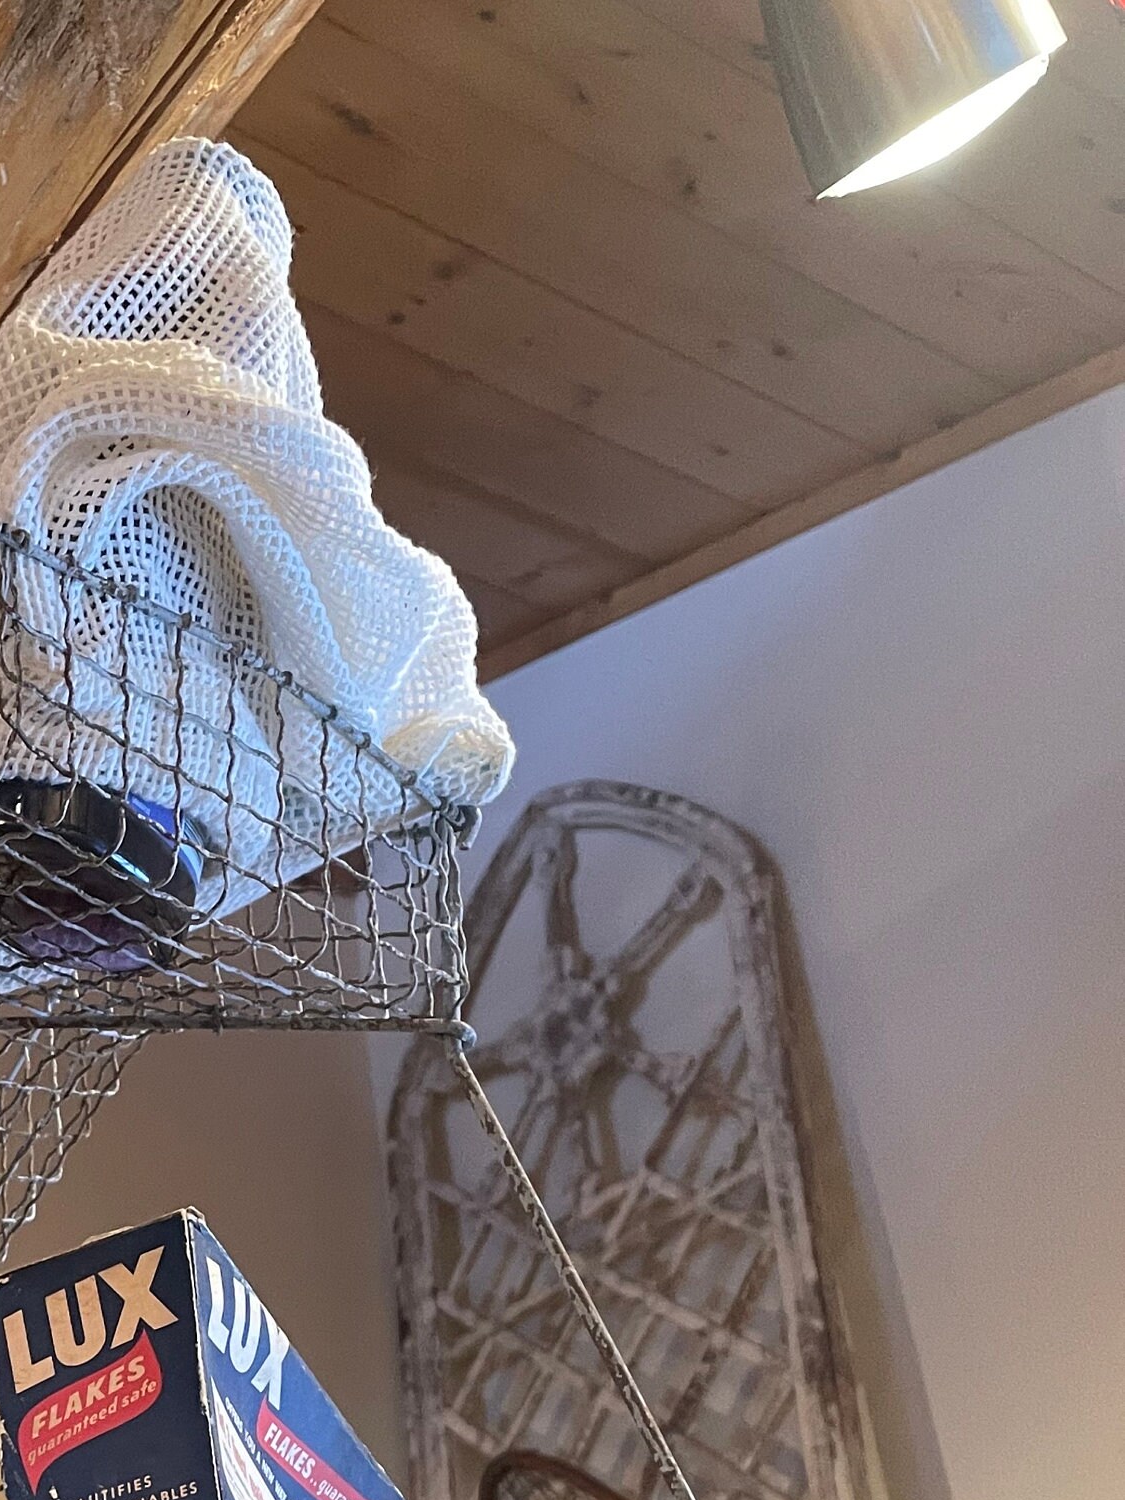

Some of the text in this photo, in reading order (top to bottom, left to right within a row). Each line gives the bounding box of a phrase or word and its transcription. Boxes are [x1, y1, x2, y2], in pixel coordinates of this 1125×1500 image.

[2, 1245, 179, 1394] LUX
[206, 1255, 290, 1411] LUX
[27, 1378, 157, 1466] guaranteed safe
[31, 1355, 147, 1439] FLAKES
